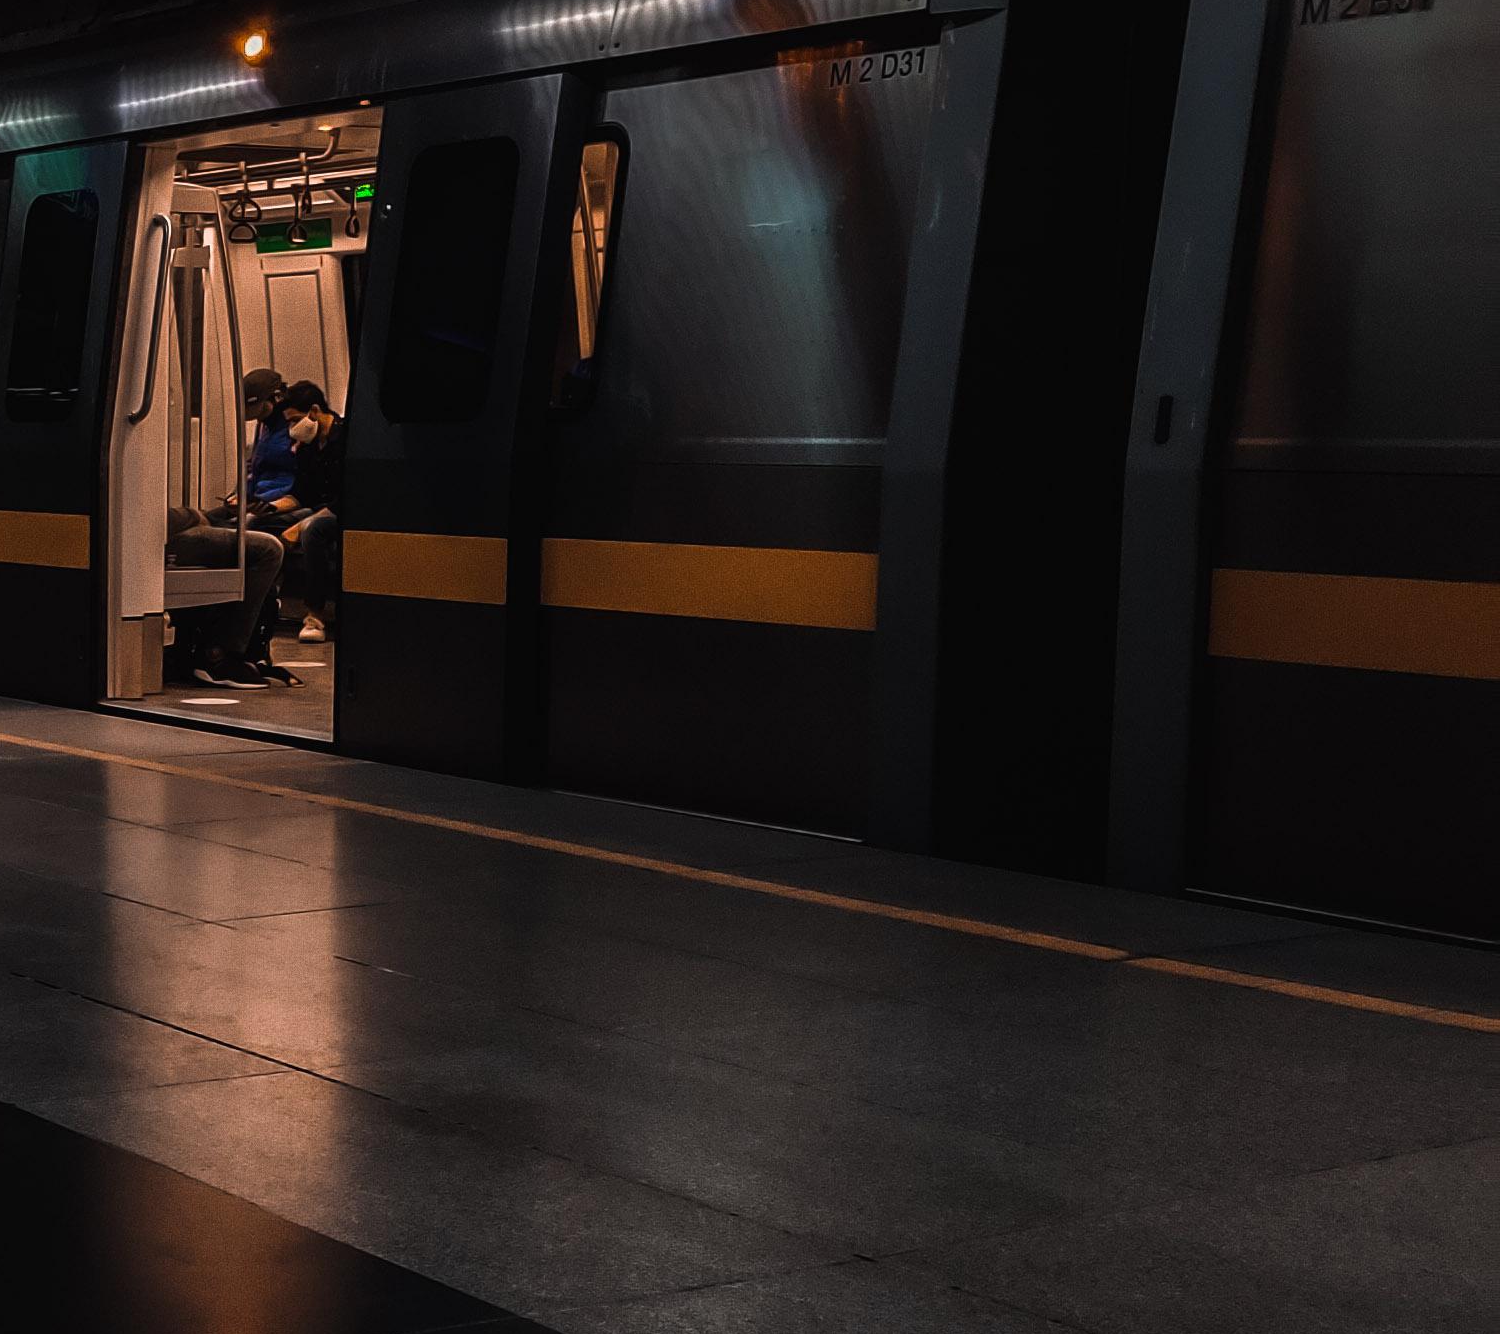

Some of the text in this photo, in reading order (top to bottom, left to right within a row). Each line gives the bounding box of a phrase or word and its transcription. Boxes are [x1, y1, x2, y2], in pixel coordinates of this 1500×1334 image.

[830, 48, 925, 87] M 2 D31
